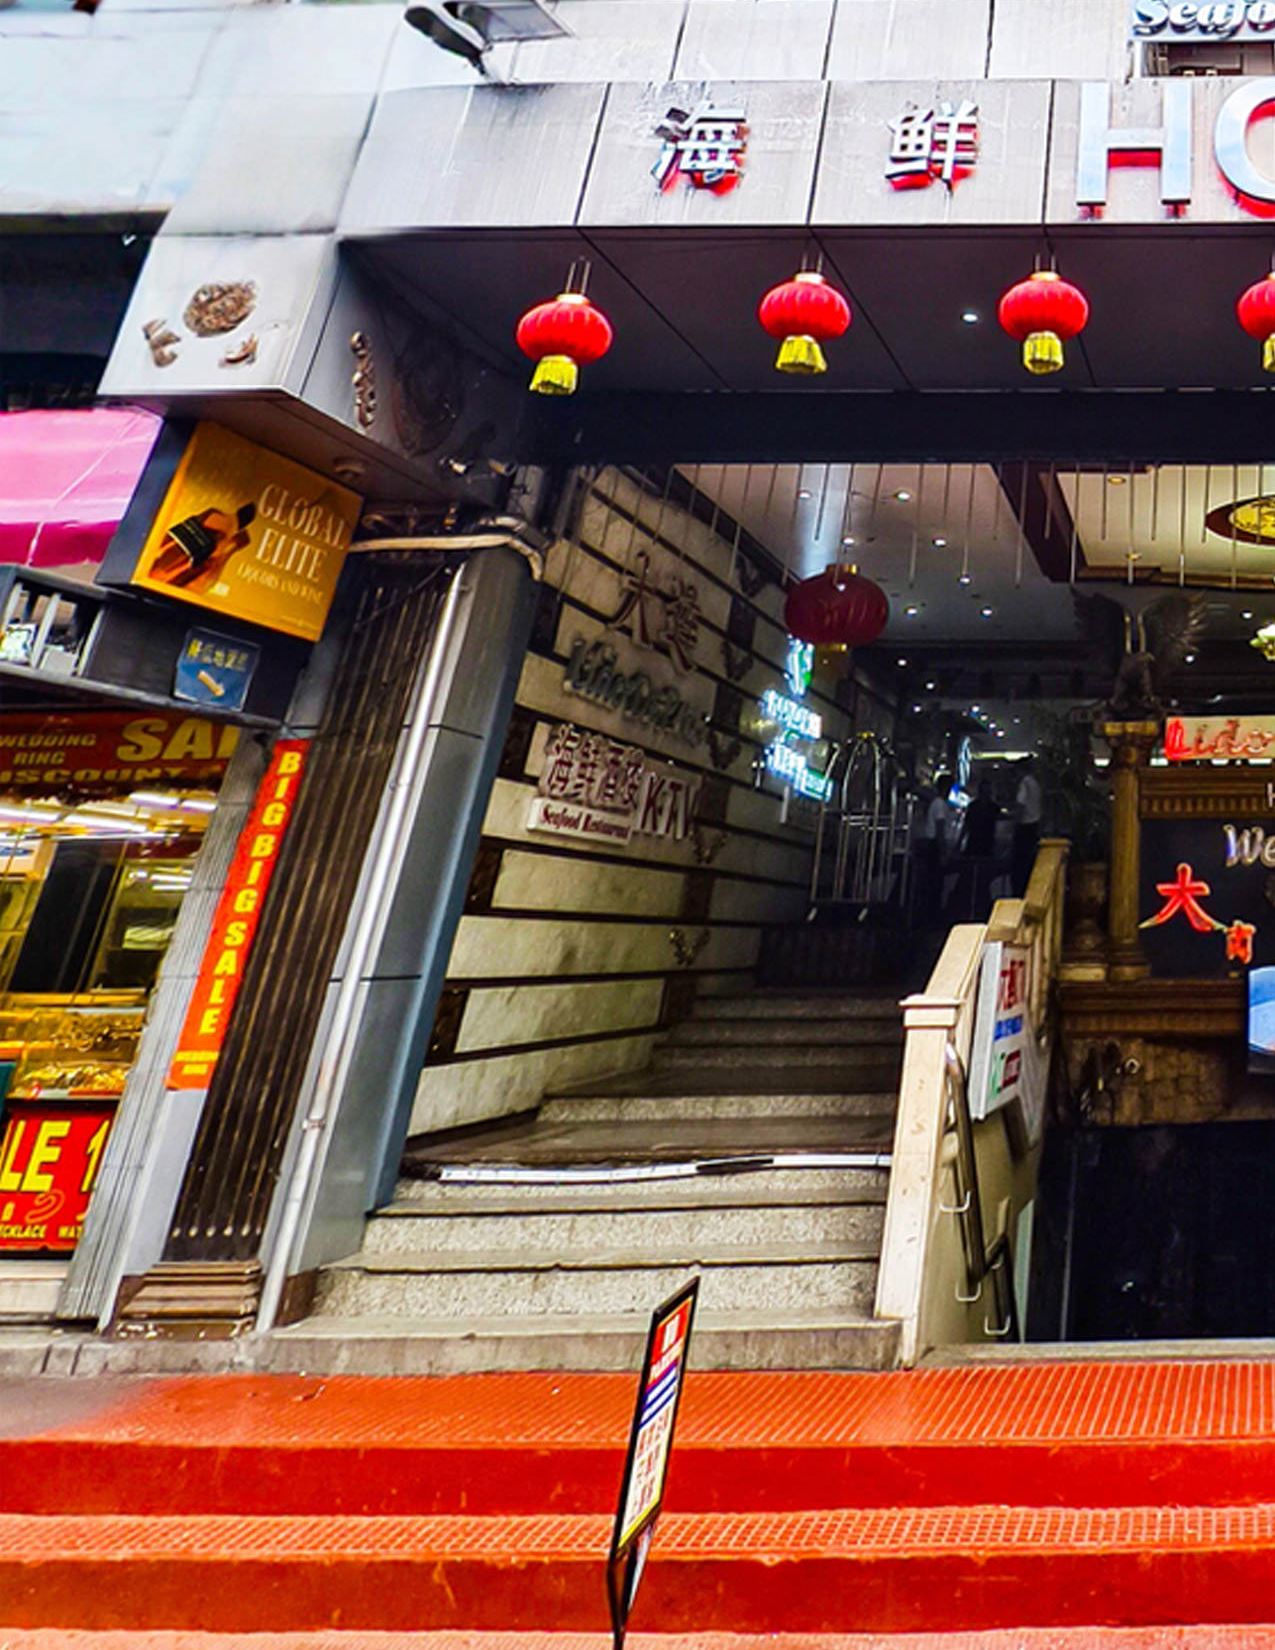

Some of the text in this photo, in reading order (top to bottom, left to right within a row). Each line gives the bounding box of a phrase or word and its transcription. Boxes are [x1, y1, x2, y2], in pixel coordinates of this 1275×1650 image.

[258, 483, 345, 550] GLOBAL
[256, 527, 328, 582] ELITE
[13, 751, 66, 766] RING
[199, 751, 301, 1035] BIG BIG SALE
[1138, 862, 1228, 932] 大
